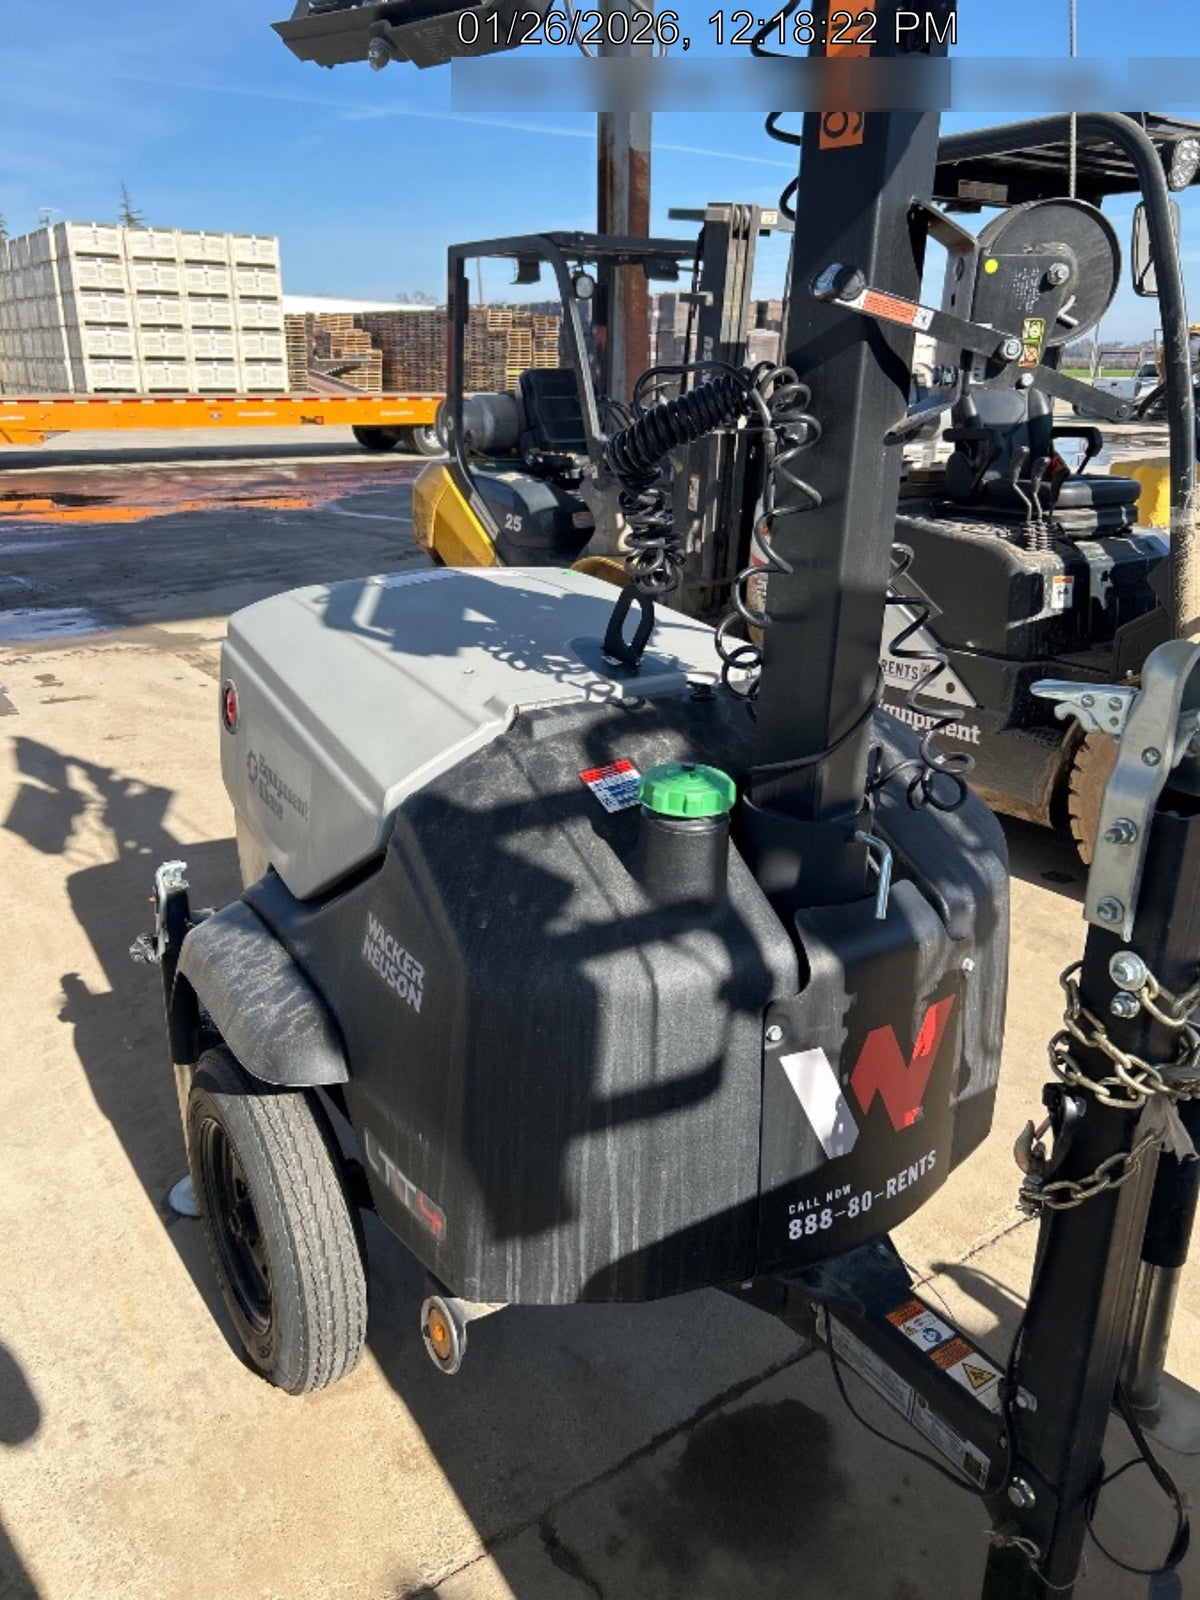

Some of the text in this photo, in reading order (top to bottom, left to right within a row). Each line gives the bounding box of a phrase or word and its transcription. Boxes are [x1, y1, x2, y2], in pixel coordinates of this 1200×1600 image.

[504, 512, 523, 532] 25
[881, 659, 919, 680] RENTS
[363, 934, 423, 1015] NEUSON
[367, 909, 425, 992] WACKER
[787, 1149, 937, 1241] 888-80-RENTS
[788, 1183, 852, 1216] CALL NOW
